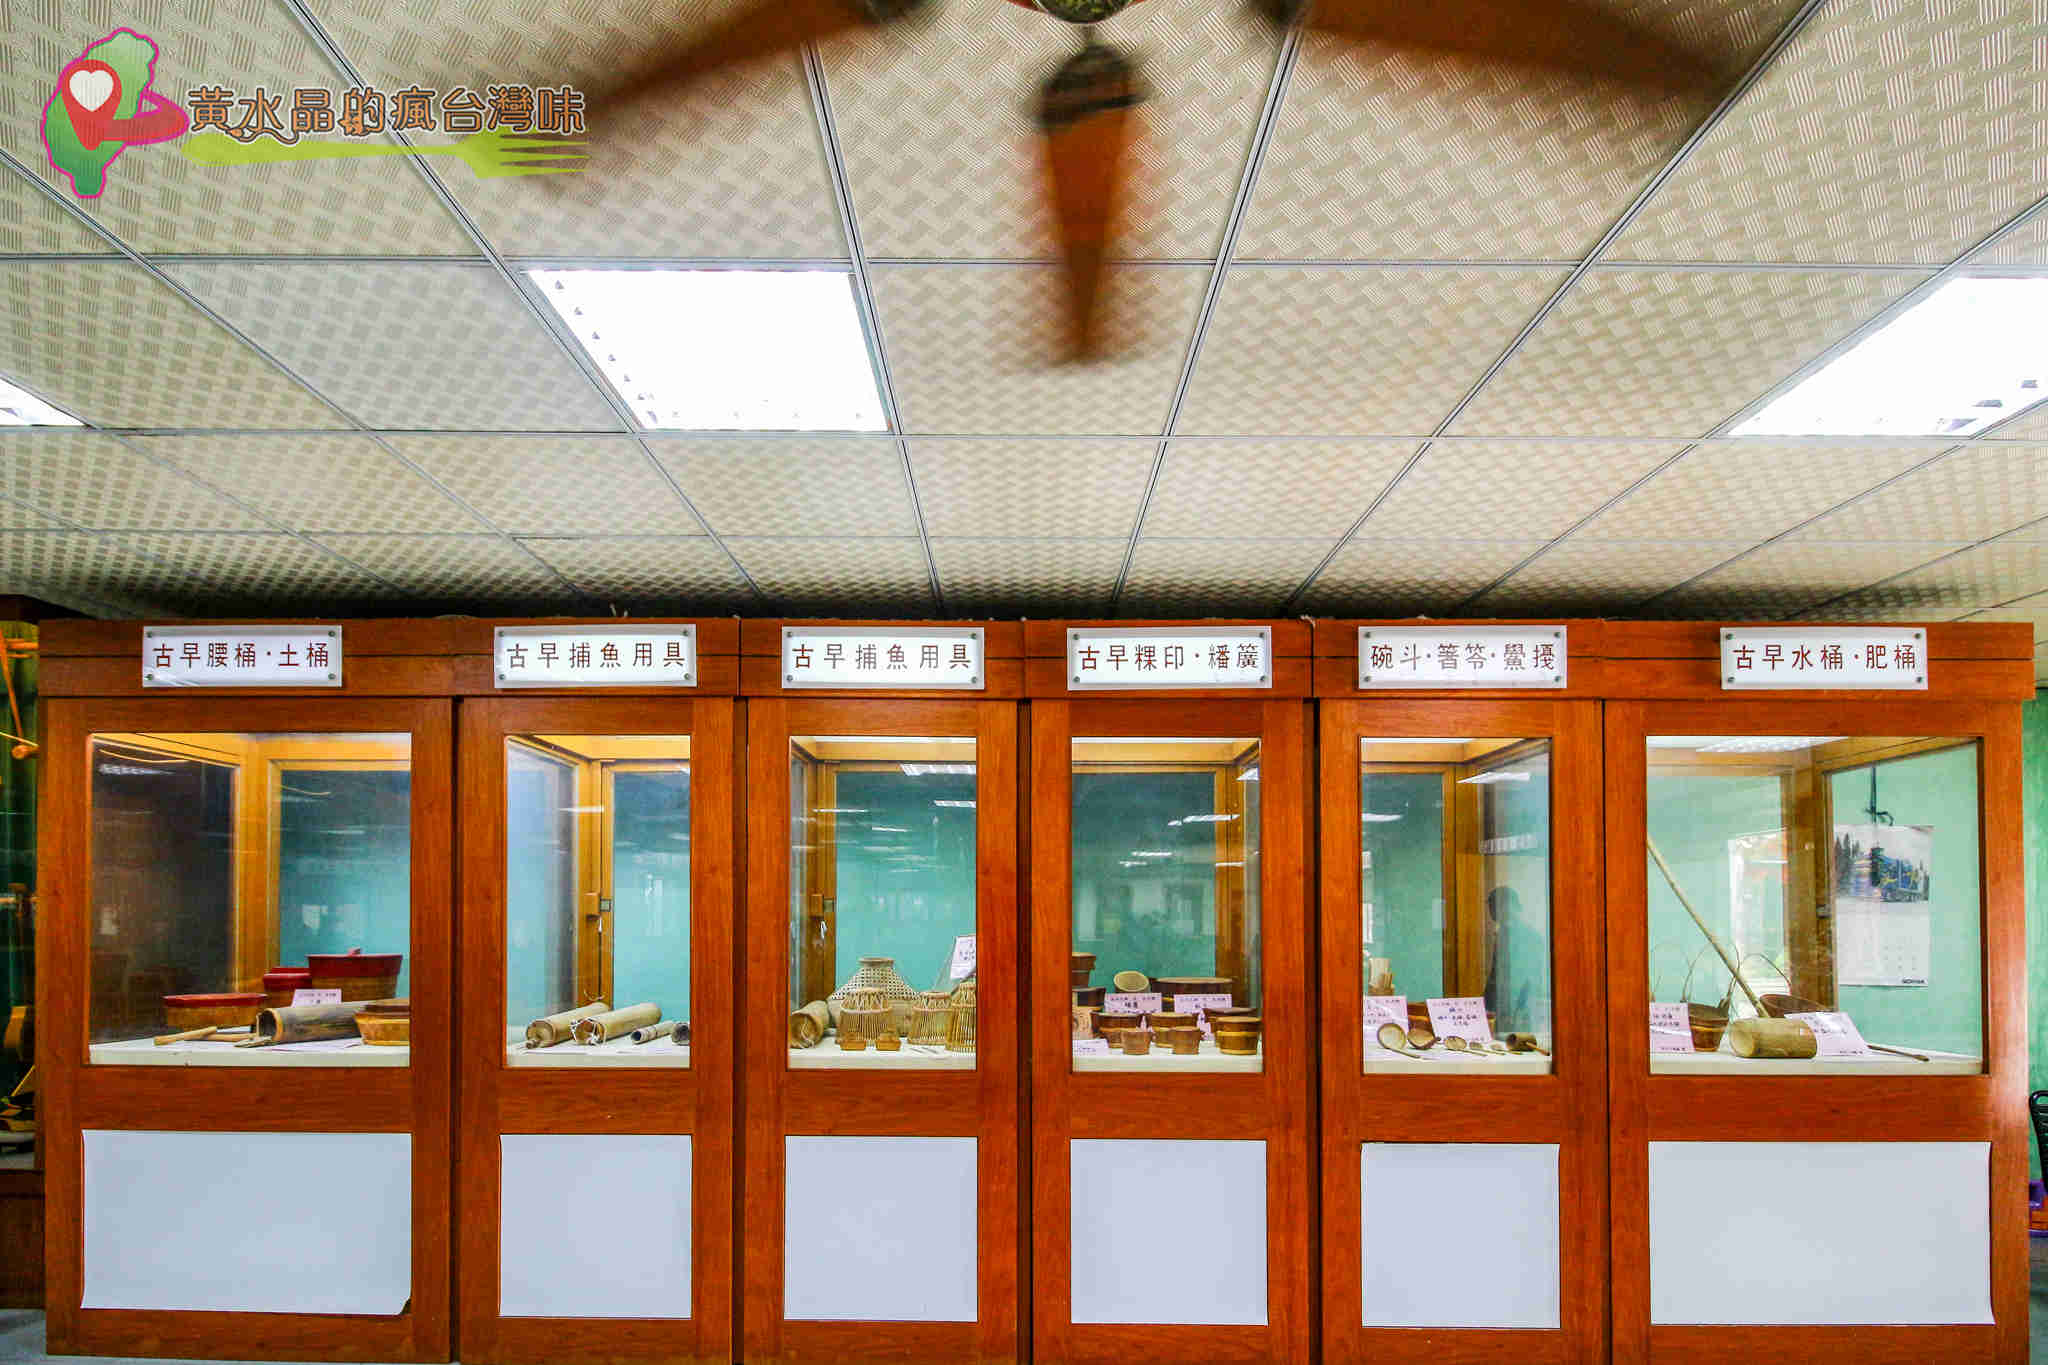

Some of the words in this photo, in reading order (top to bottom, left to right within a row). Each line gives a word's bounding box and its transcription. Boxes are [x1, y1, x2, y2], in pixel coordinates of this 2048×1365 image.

[508, 641, 685, 668] 古早捕魚用具
[793, 643, 971, 669] 古早捕魚用具
